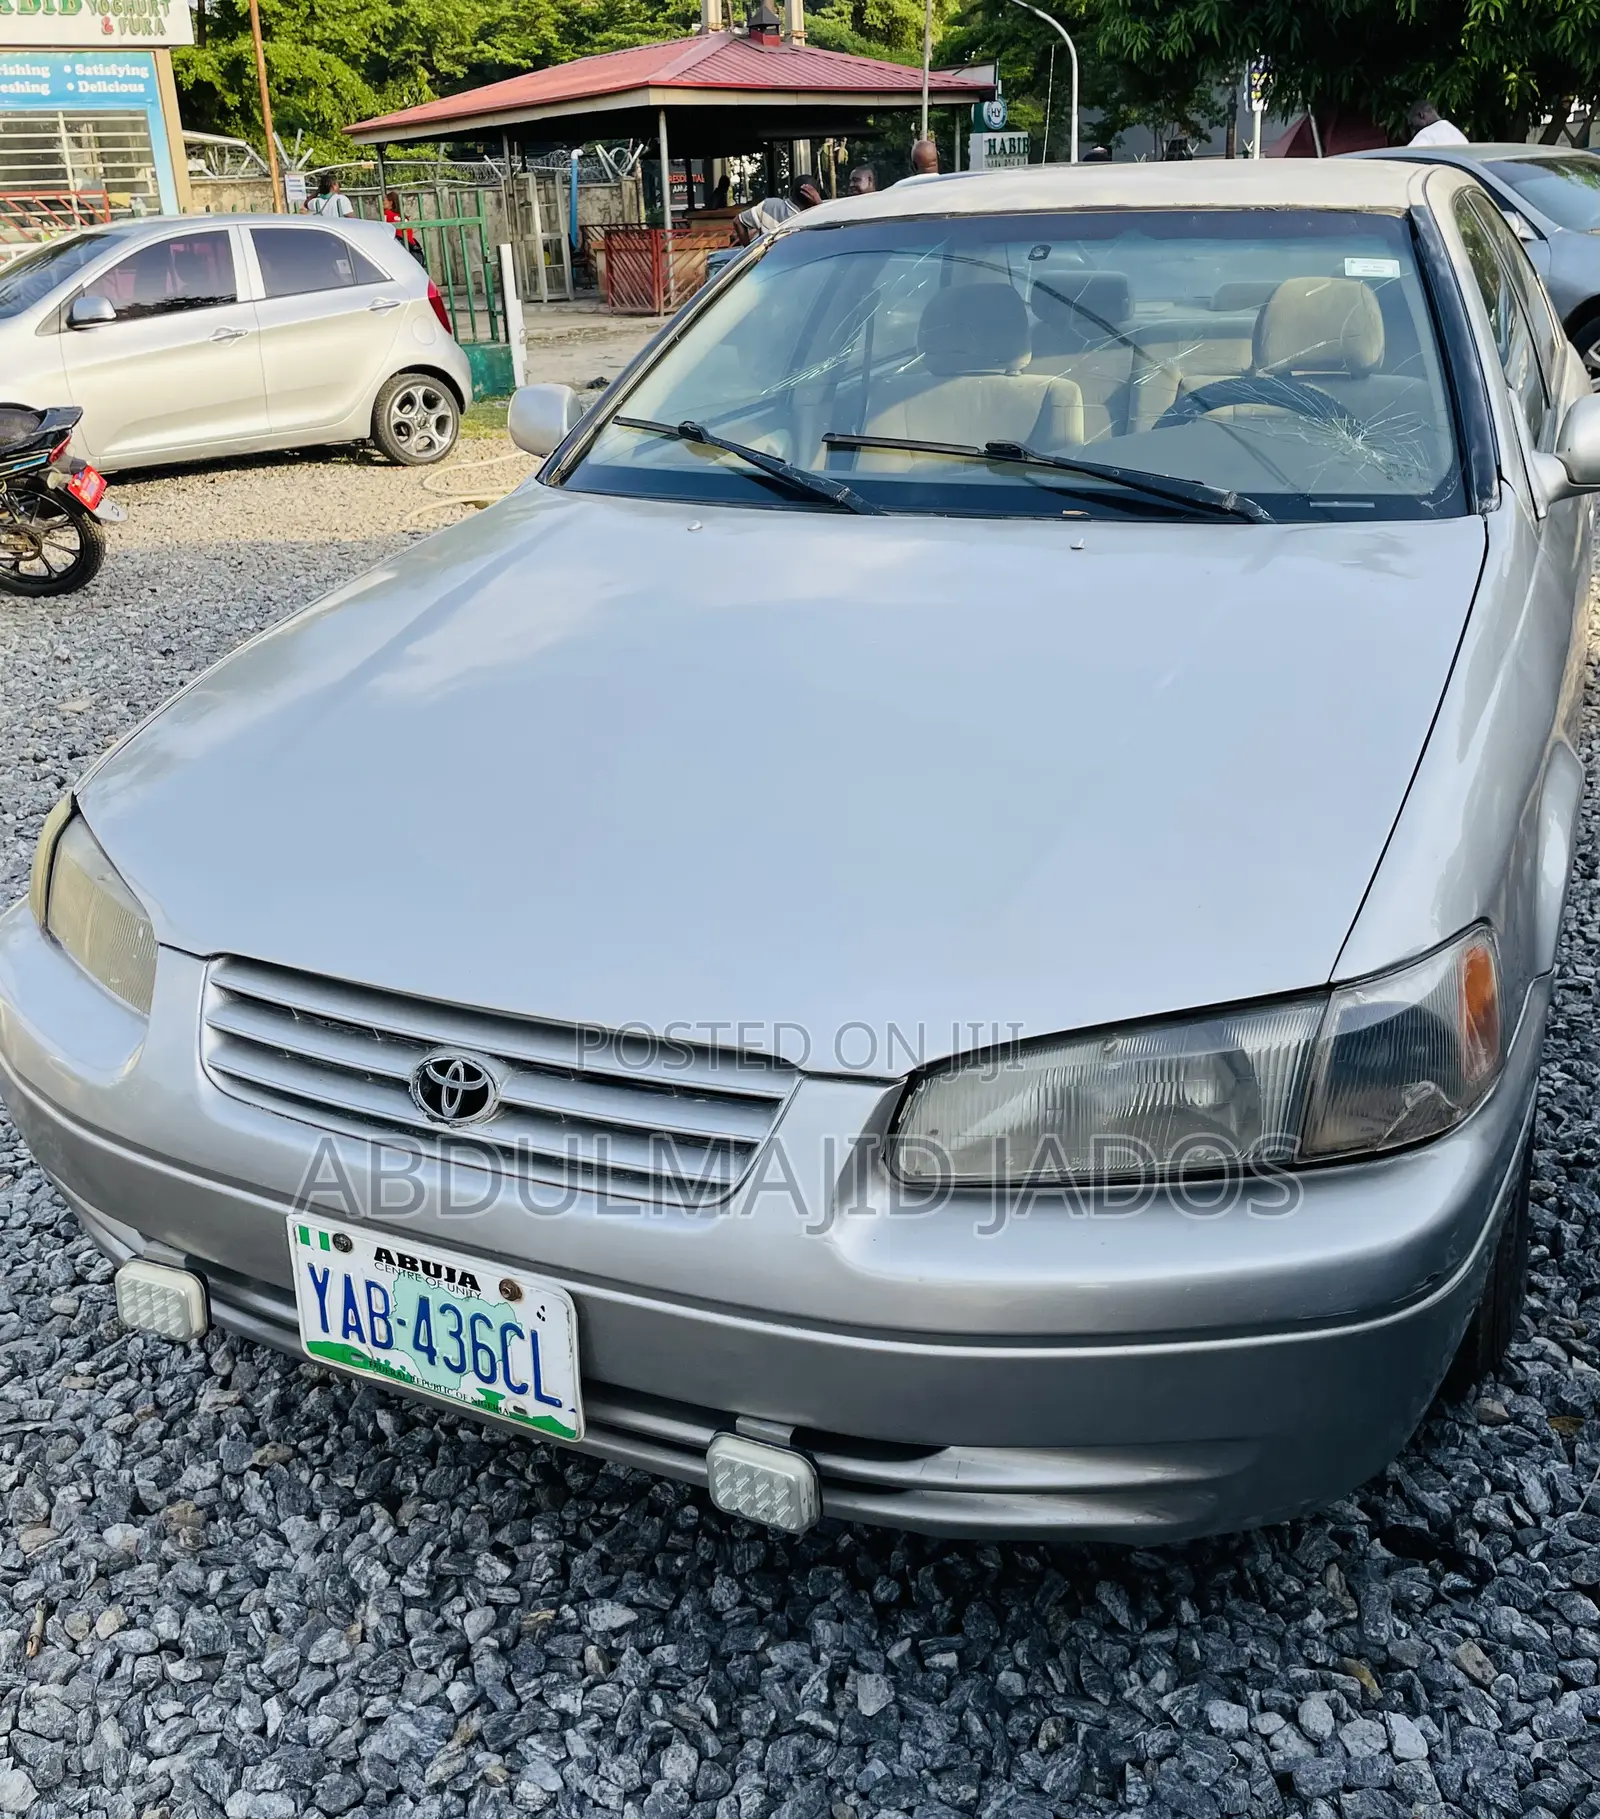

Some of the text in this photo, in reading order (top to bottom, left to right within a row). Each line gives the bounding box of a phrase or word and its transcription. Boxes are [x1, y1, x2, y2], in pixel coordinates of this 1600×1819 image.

[85, 0, 171, 17] YOGHURT
[101, 16, 167, 36] & FURA
[75, 63, 149, 79] Satisfying
[77, 80, 145, 93] Delicious
[987, 137, 1030, 156] HABIB
[373, 1247, 481, 1292] ABUJA
[374, 1261, 481, 1300] CENTRE OF UNITY
[307, 1262, 563, 1409] YAB-436CL
[410, 1374, 453, 1397] REPUBLIC
[456, 1391, 468, 1401] OF
[470, 1396, 510, 1416] NIGERIA
